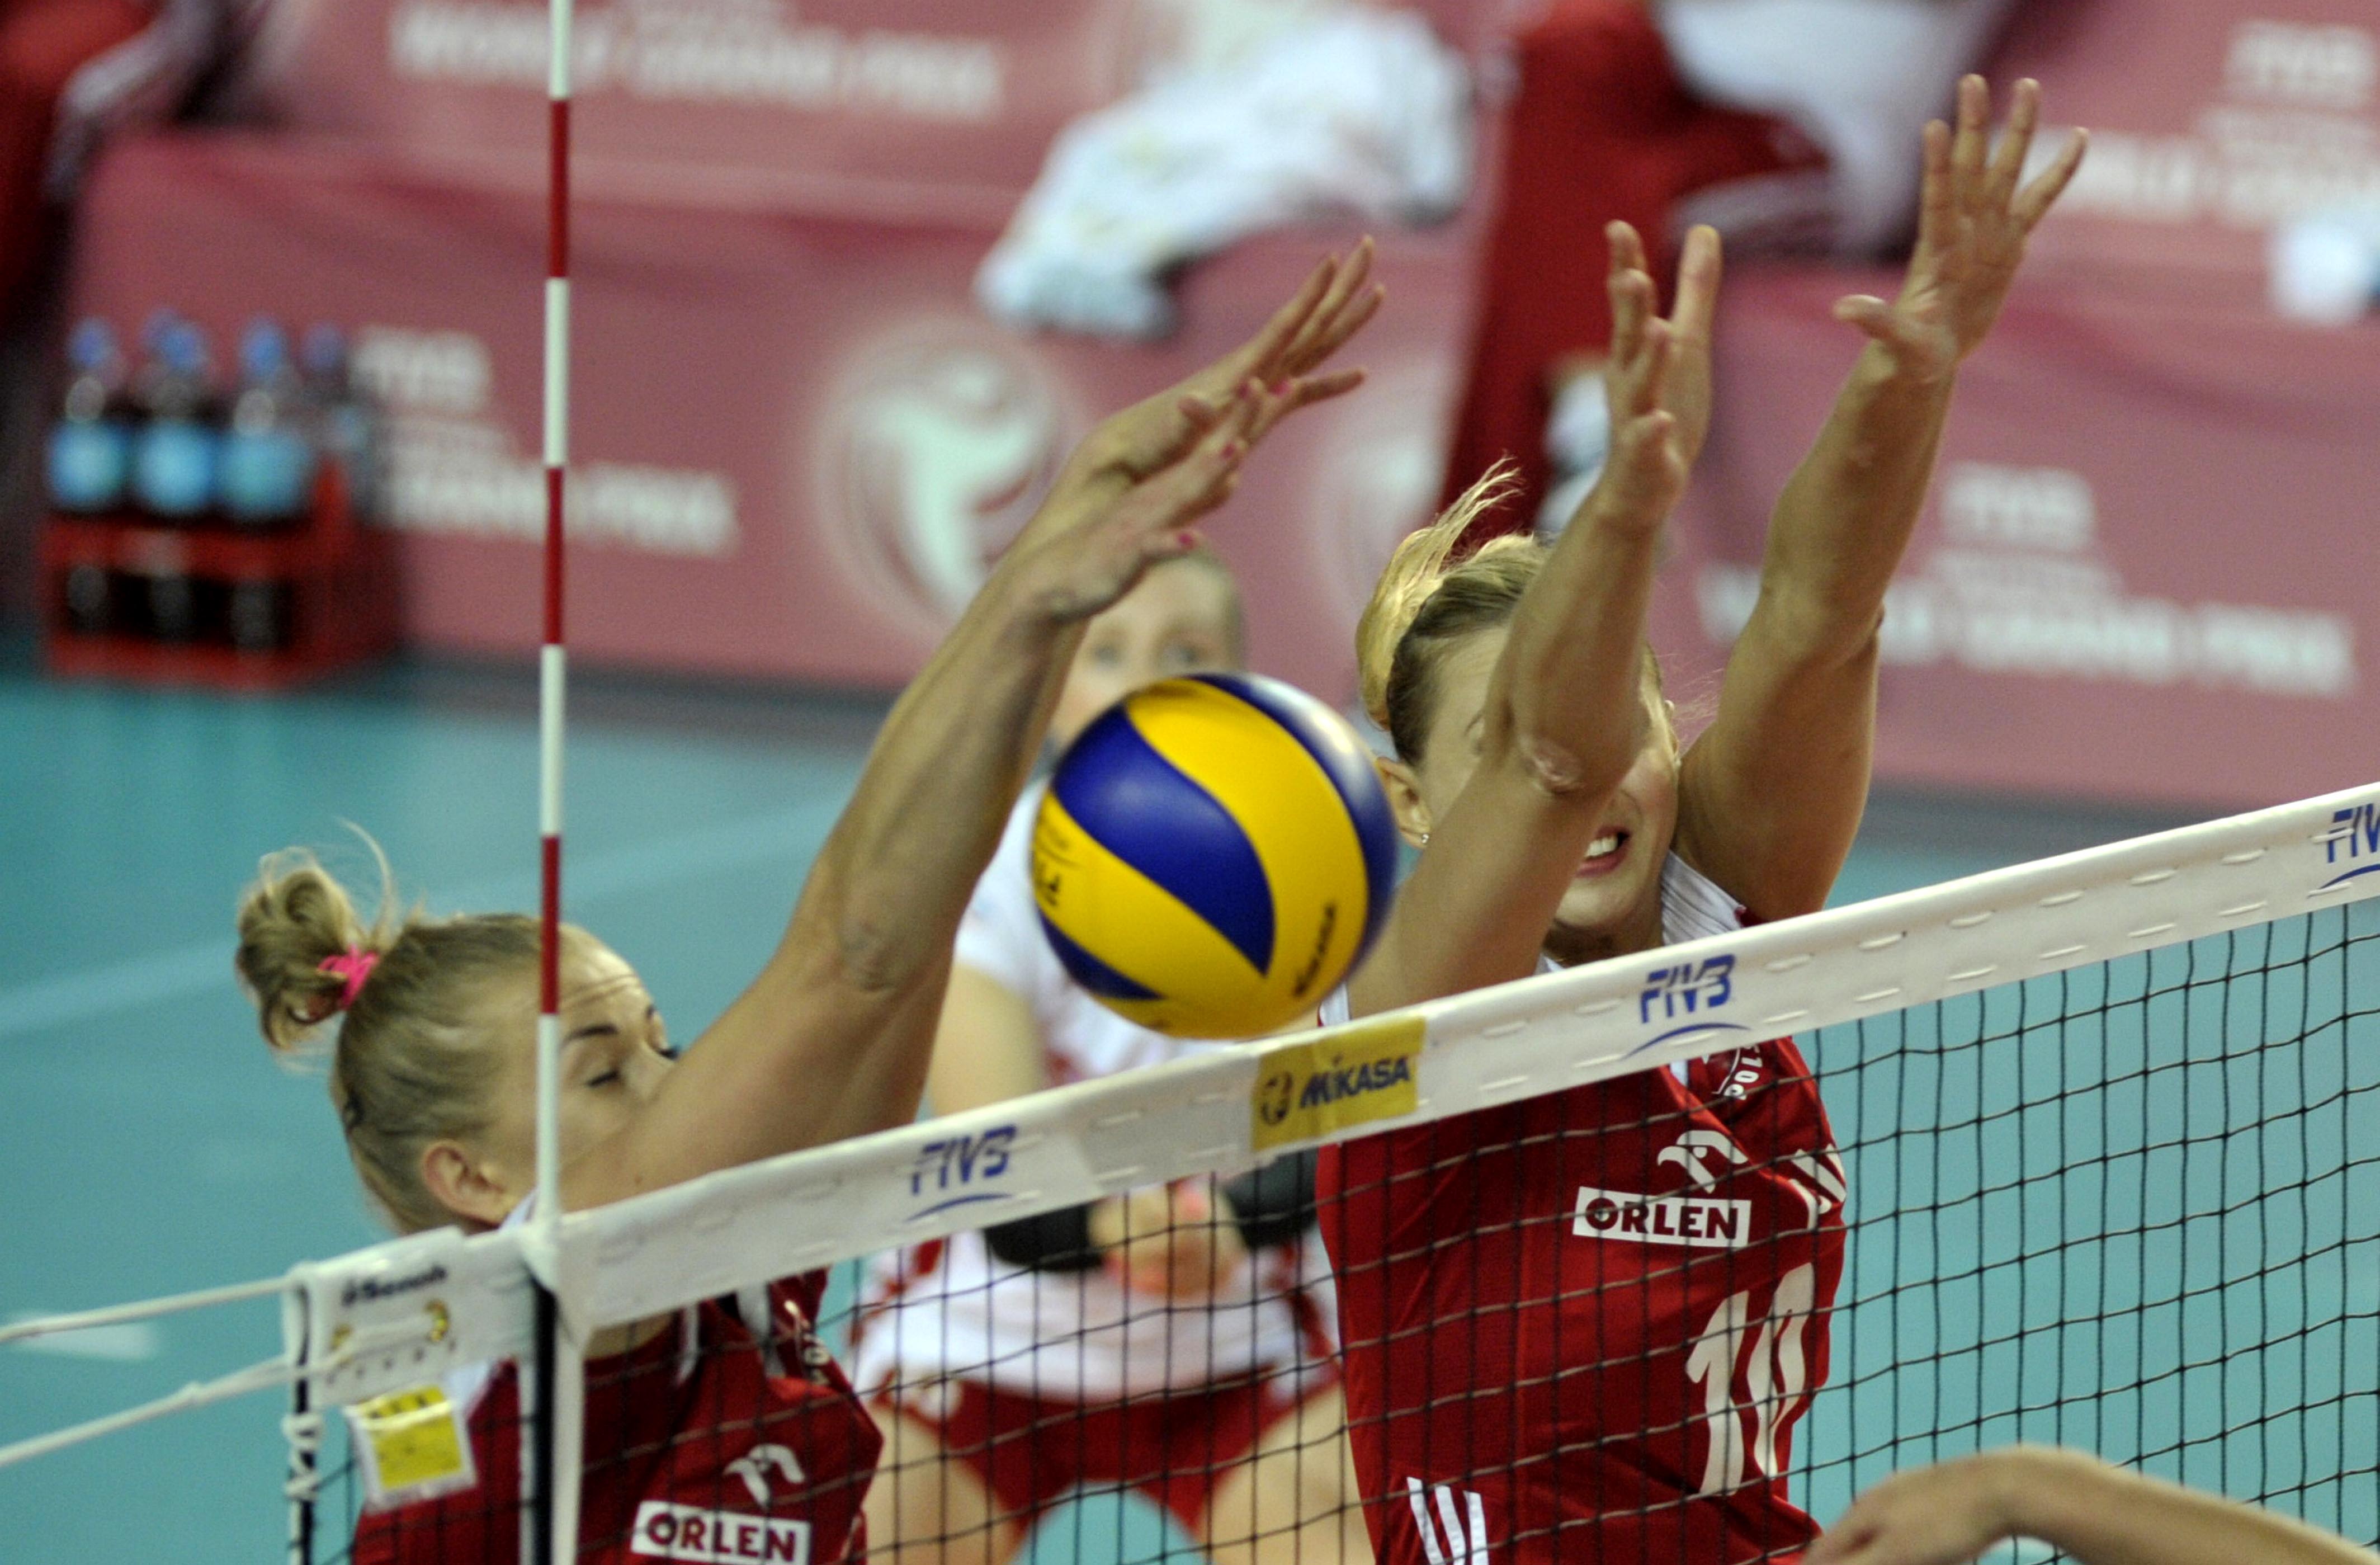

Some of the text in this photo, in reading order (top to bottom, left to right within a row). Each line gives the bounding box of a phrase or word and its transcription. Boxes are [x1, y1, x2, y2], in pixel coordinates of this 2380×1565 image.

[1641, 954, 1736, 1024] FIVB
[911, 1125, 1017, 1196] FIVB
[1585, 1197, 1739, 1239] ORLEN
[1685, 1262, 1815, 1496] 10
[646, 1512, 796, 1562] ORLEN
